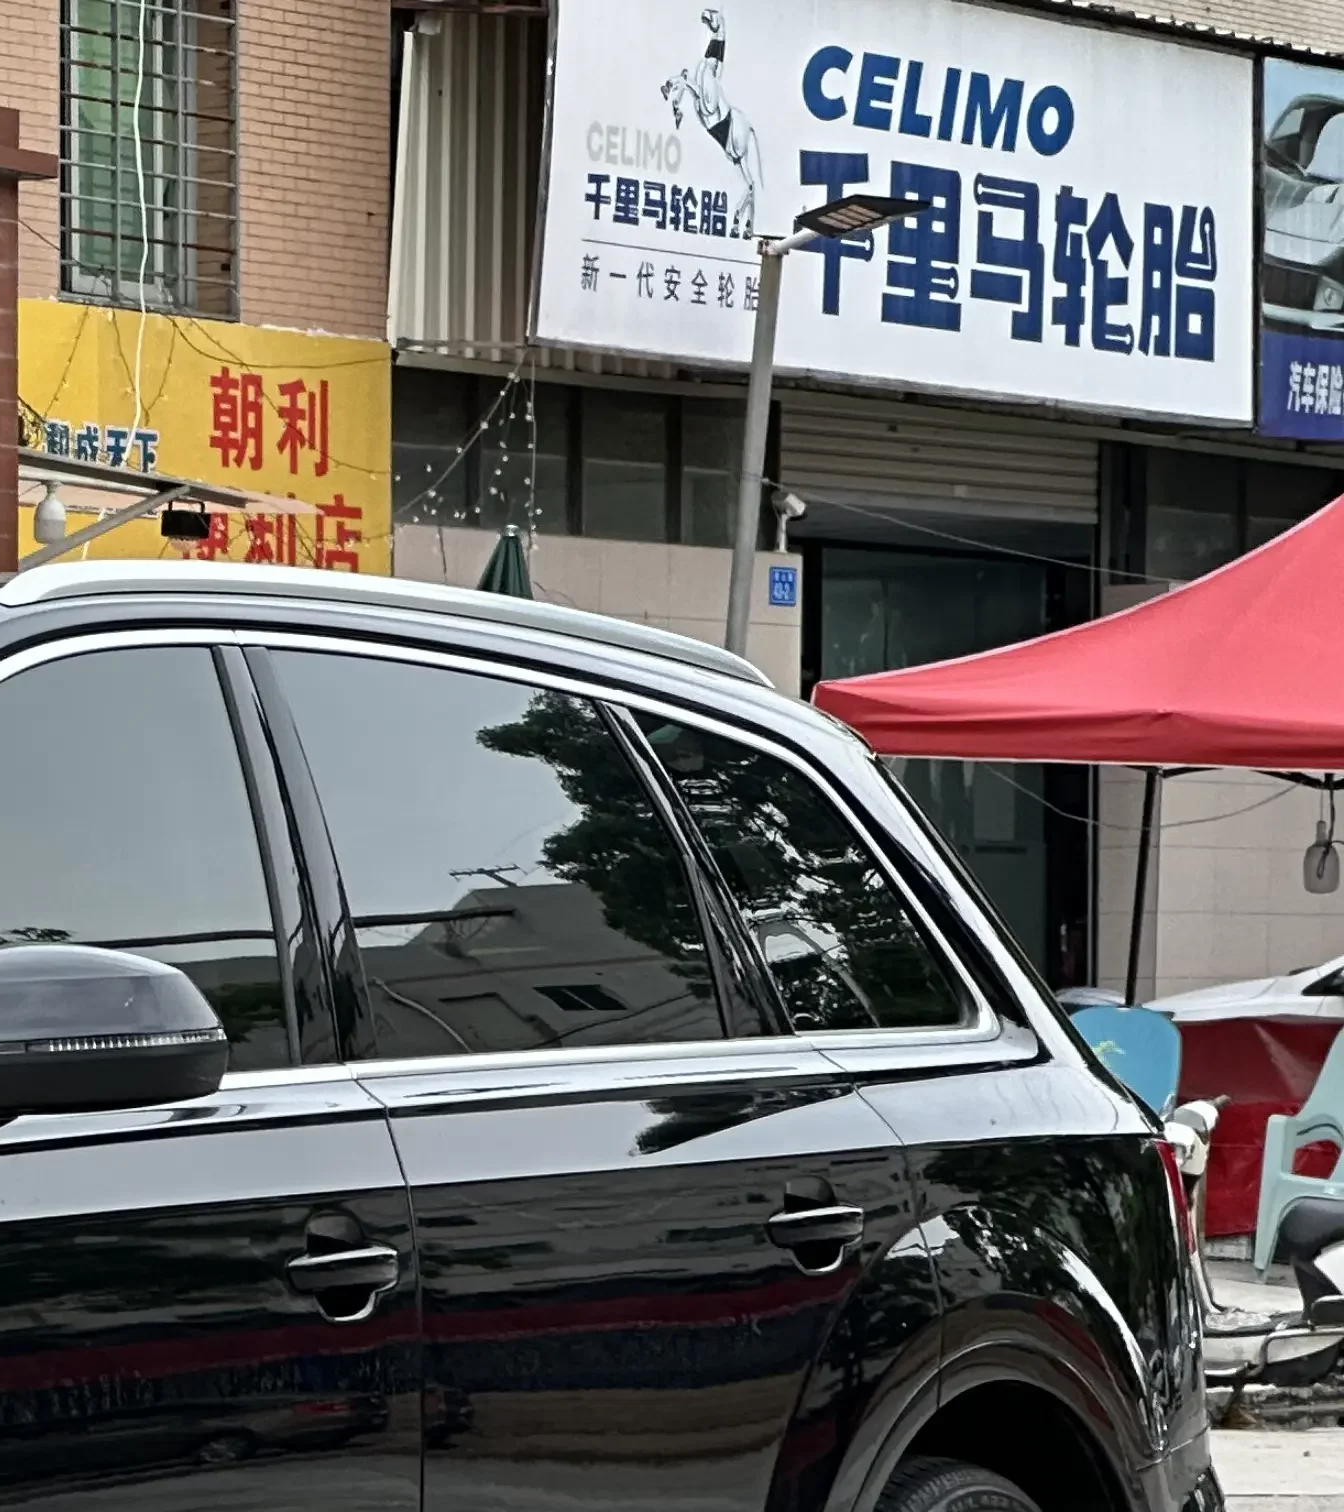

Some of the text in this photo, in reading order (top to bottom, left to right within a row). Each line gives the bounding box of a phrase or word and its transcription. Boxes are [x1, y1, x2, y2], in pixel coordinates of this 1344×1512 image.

[802, 45, 1075, 157] CELIMO
[585, 120, 682, 175] CELIMO
[584, 173, 728, 238] 千里马轮胎
[792, 149, 1217, 363] 千里马轮胎
[209, 366, 329, 477] 朝利
[1287, 361, 1344, 415] 汽车保险
